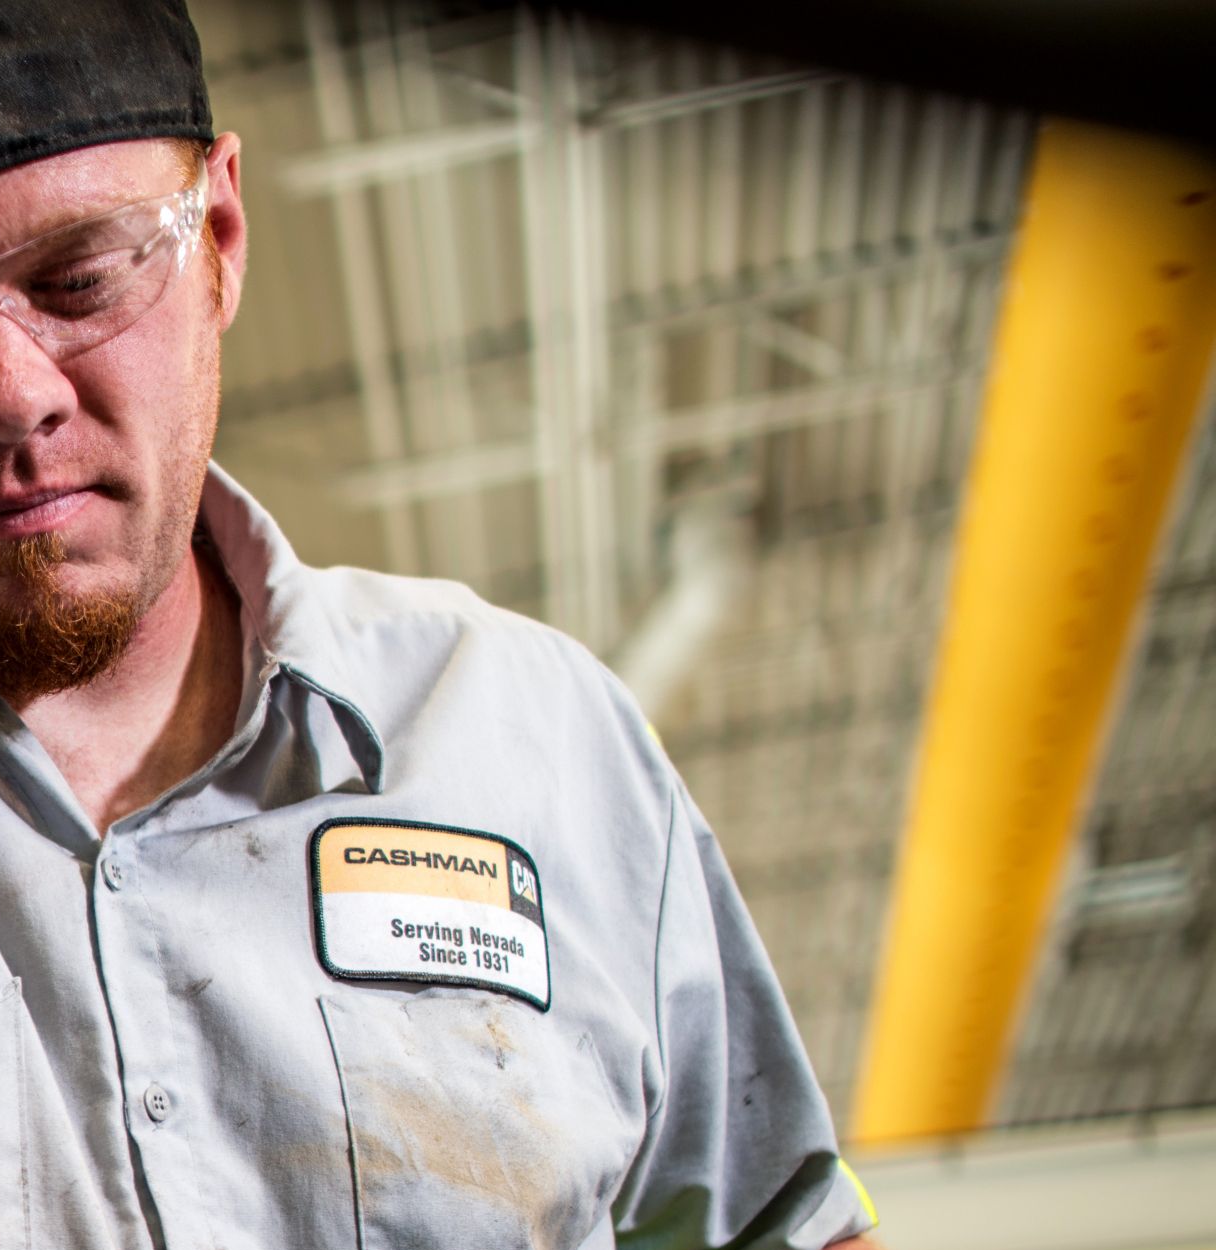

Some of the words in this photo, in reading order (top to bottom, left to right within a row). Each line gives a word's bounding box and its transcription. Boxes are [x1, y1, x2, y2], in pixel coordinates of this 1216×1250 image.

[344, 847, 498, 879] CASHMAN
[512, 860, 538, 903] CAT
[391, 918, 464, 947] Serving
[470, 926, 525, 958] Nevada
[419, 943, 468, 966] Since
[473, 949, 510, 973] 1931
